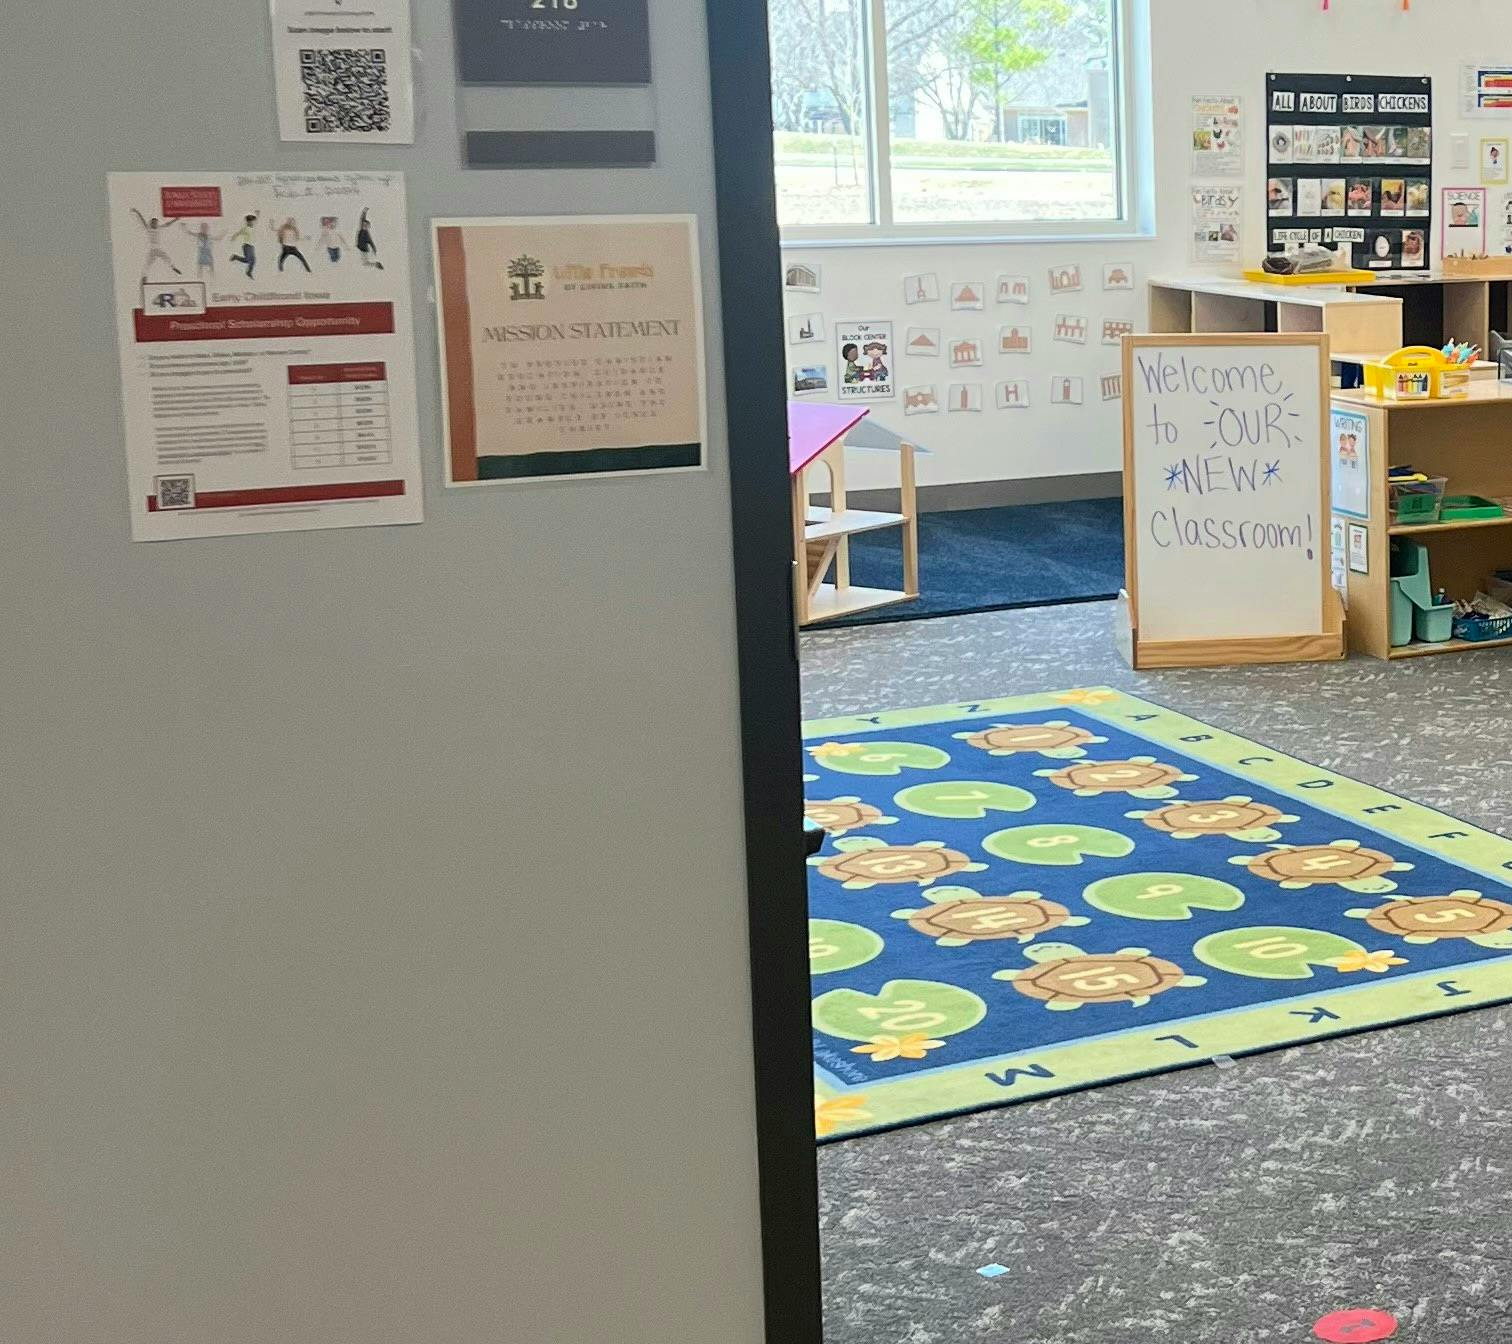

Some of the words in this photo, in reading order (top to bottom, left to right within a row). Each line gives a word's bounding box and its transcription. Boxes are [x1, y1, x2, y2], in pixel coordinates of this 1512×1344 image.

[1275, 95, 1292, 110] ALL
[1301, 96, 1337, 111] ABOUT
[1344, 97, 1373, 111] BIRDS
[1379, 96, 1426, 110] CHICKENS
[1447, 192, 1480, 201] SCIENCE
[482, 325, 566, 344] MISSION
[570, 320, 681, 340] STATEMENT
[1138, 352, 1283, 394] Welcome
[842, 385, 891, 395] STRUCTURES
[1146, 403, 1178, 445] to
[1218, 402, 1291, 448] OUR
[1126, 713, 1158, 723] A
[1238, 756, 1273, 766] C
[1090, 770, 1141, 782] 2
[1298, 779, 1334, 790] D
[1188, 809, 1238, 825] 3
[1362, 804, 1402, 815] E
[1027, 835, 1080, 848] 8
[1428, 831, 1470, 841] F
[859, 855, 927, 875] 13
[1302, 854, 1352, 871] 4
[1136, 883, 1184, 900] 9
[952, 906, 1028, 931] 14
[1414, 908, 1475, 924] 5
[1233, 935, 1309, 959] 10
[1059, 966, 1140, 992] 15
[858, 999, 948, 1032] 20
[1289, 1007, 1340, 1024] K
[1155, 1034, 1199, 1049] L
[985, 1063, 1056, 1088] M
